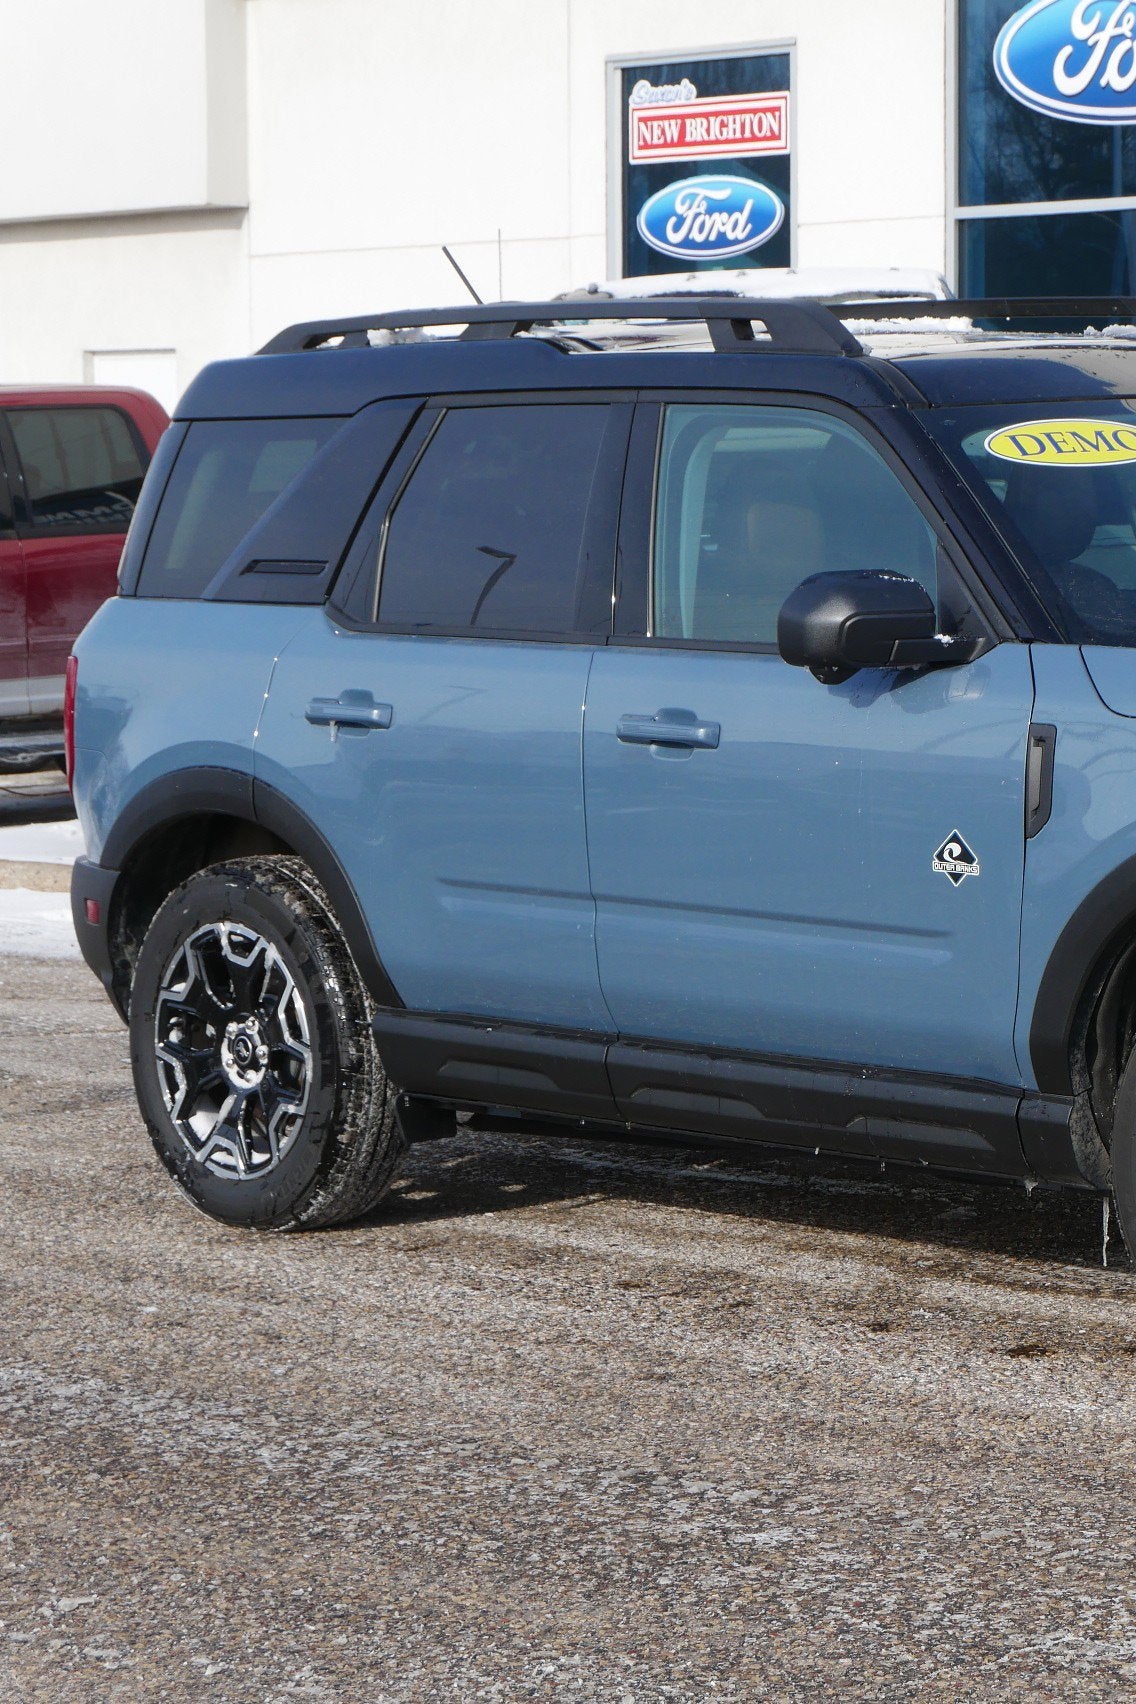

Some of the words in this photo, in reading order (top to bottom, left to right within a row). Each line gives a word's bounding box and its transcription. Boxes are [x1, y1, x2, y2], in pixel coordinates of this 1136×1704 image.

[638, 119, 682, 146] NEW
[684, 111, 780, 143] BRIGHTON
[666, 187, 754, 244] Ford
